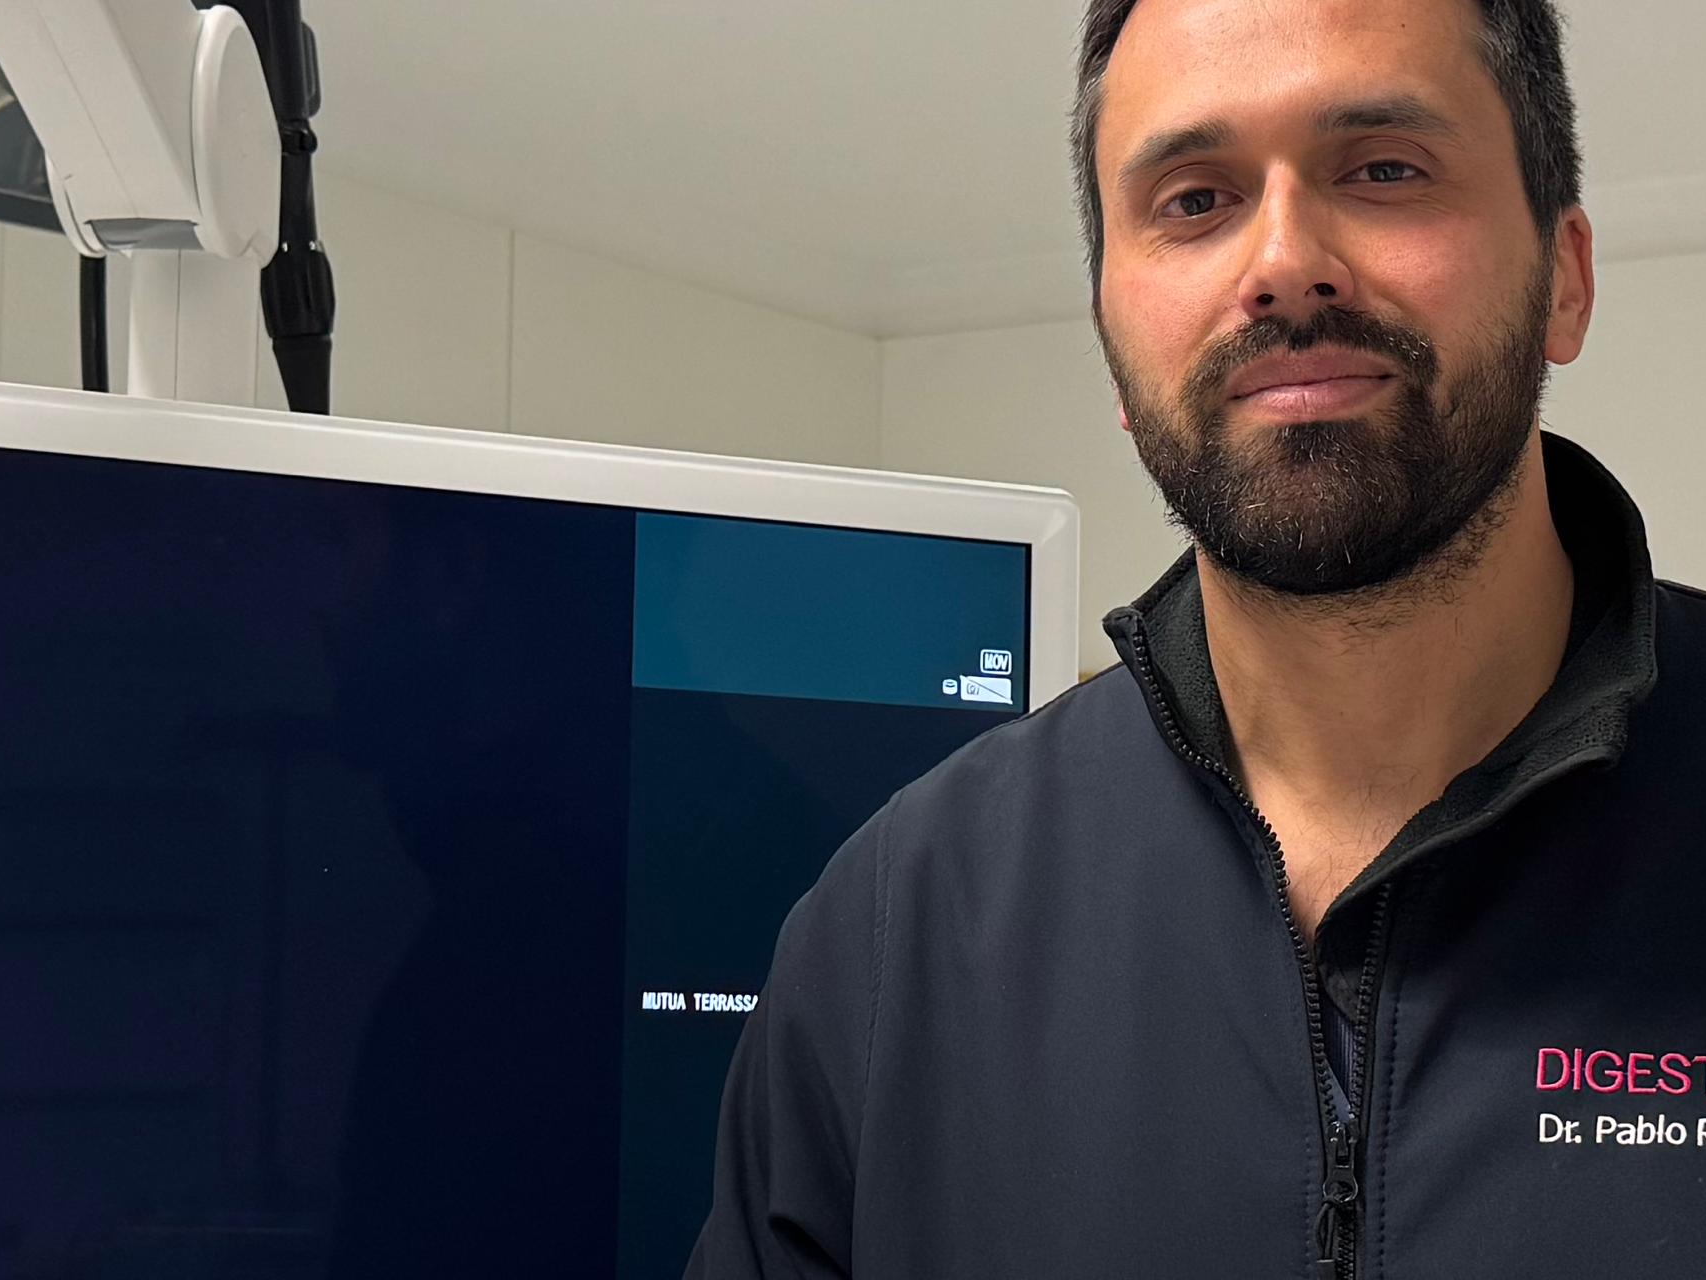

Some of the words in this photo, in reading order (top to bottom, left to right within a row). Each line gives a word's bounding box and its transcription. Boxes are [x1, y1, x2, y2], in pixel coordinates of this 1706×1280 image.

[642, 991, 686, 1011] MUTUA
[1538, 1112, 1582, 1144] Dr.
[1595, 1113, 1687, 1146] Pablo
